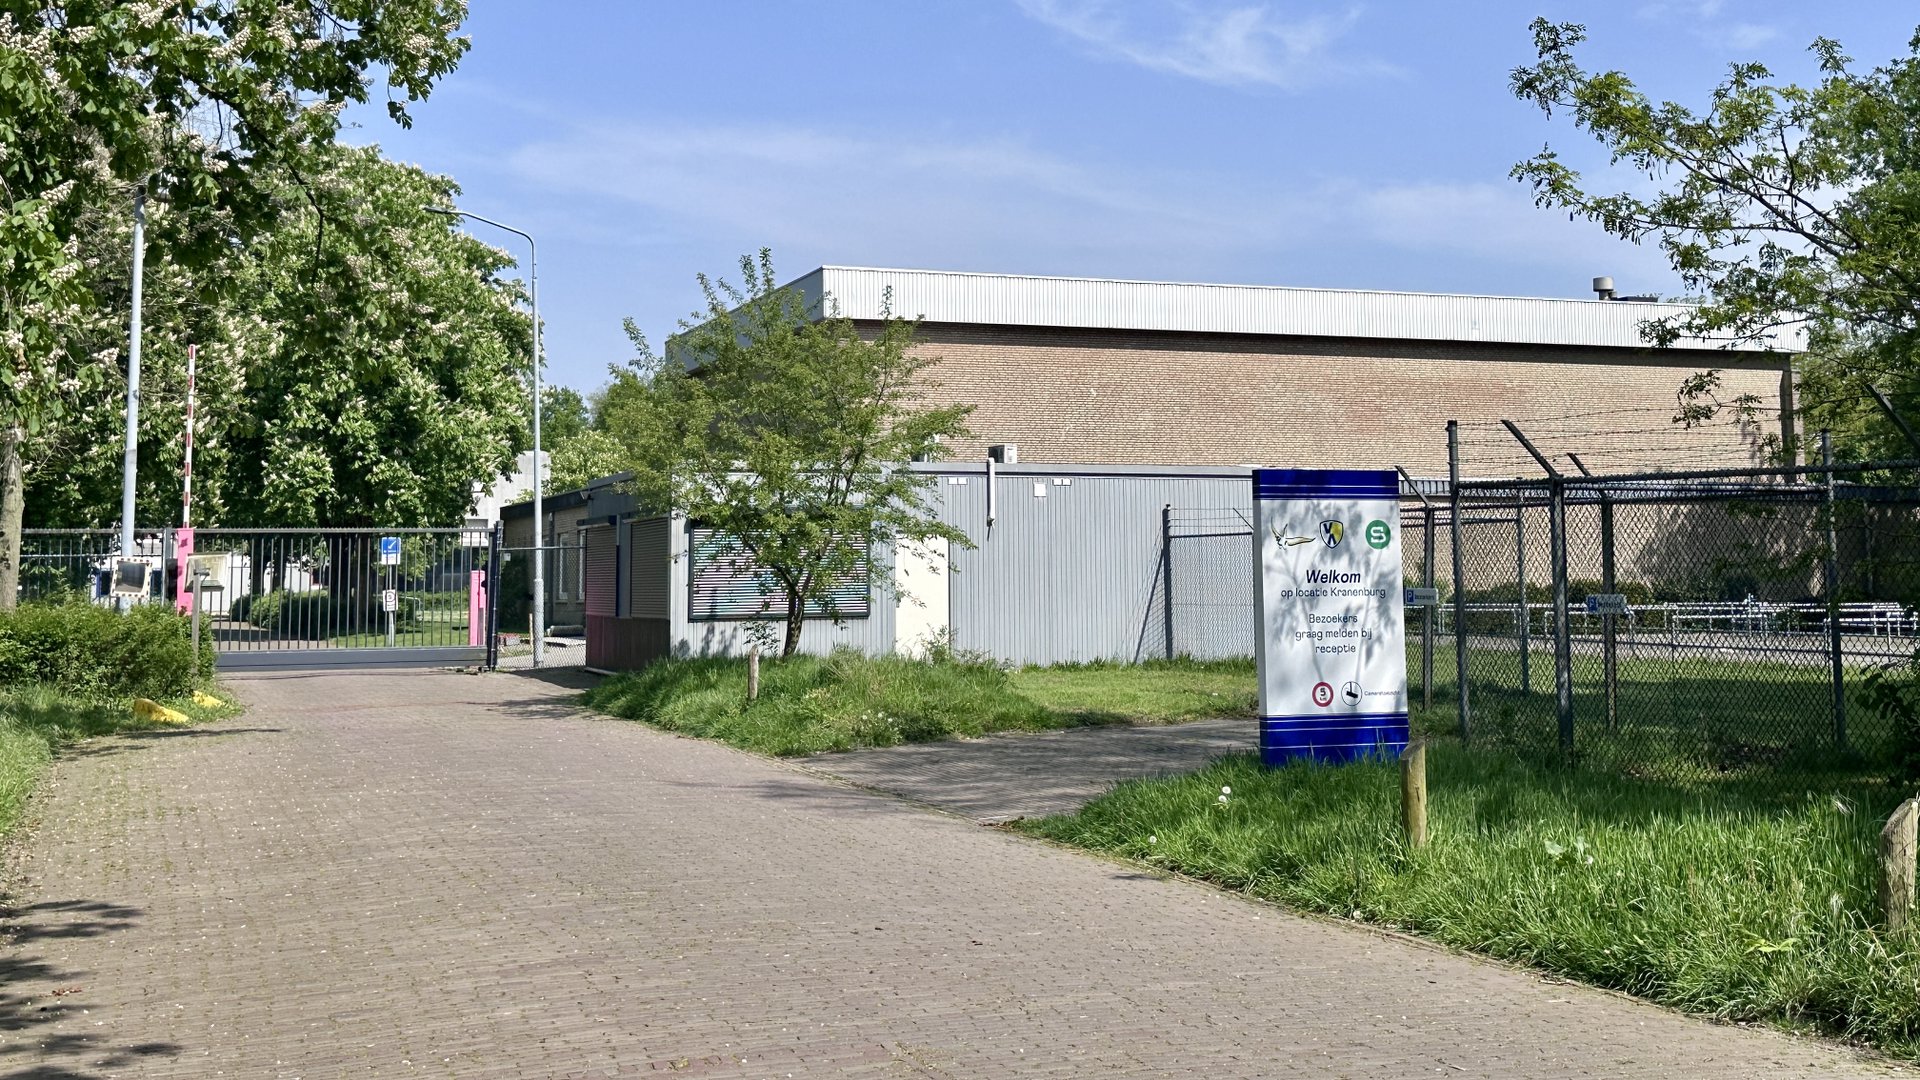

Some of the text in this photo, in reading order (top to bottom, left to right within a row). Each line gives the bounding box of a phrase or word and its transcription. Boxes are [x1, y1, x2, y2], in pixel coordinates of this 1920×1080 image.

[1306, 569, 1361, 583] Welkom
[1280, 587, 1386, 599] op locatie Kranenburg
[1308, 613, 1358, 624] Bezoekers
[1295, 628, 1372, 641] graag melden bij
[1315, 644, 1356, 655] receptie
[1319, 687, 1326, 697] 5
